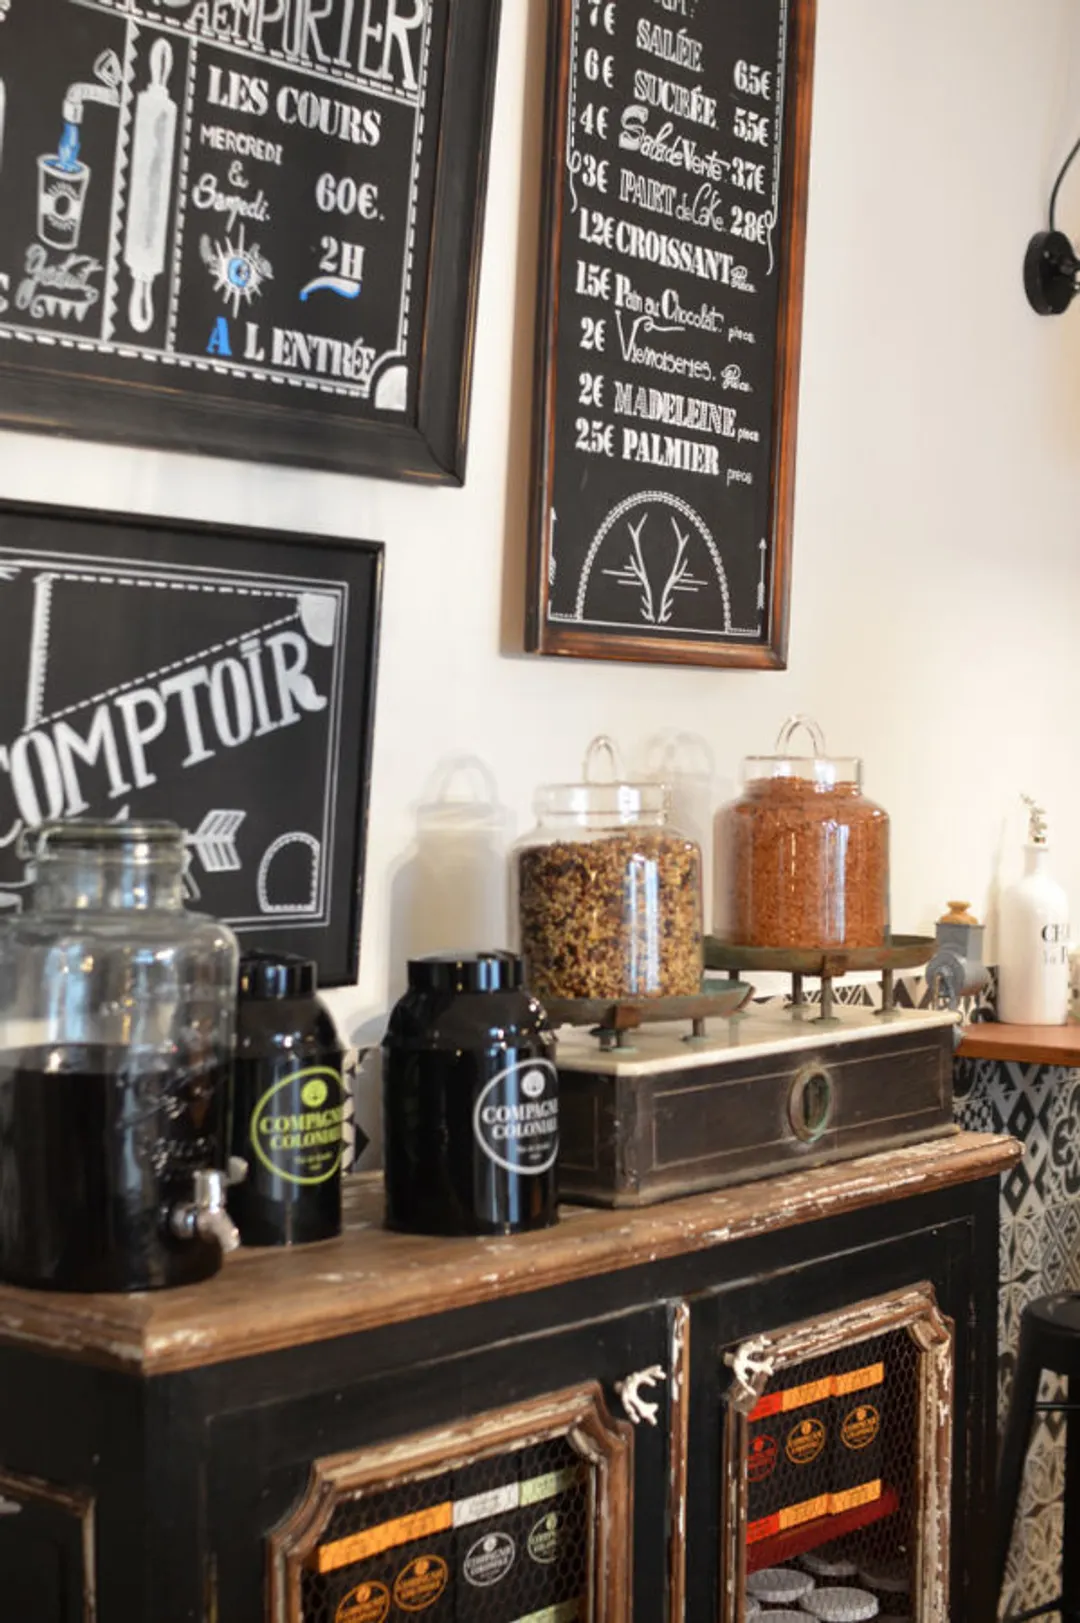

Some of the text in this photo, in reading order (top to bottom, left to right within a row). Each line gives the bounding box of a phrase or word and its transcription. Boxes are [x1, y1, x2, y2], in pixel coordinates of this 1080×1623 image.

[588, 0, 617, 35] 7€
[584, 48, 615, 89] 6€
[206, 64, 382, 146] LES COURS
[580, 103, 610, 140] 4€
[200, 123, 283, 166] MERCREDI
[227, 160, 249, 189] &
[582, 154, 611, 194] 3€
[619, 168, 678, 217] PART
[675, 192, 694, 221] de
[319, 236, 365, 281] 2H
[615, 220, 734, 285] CROISSANT
[614, 273, 644, 313] Pain
[206, 315, 232, 357] A
[243, 321, 265, 362] L
[580, 316, 607, 352] 2€
[578, 372, 605, 408] 2€
[613, 380, 737, 438] MADELEINE
[621, 427, 720, 476] PALMIER
